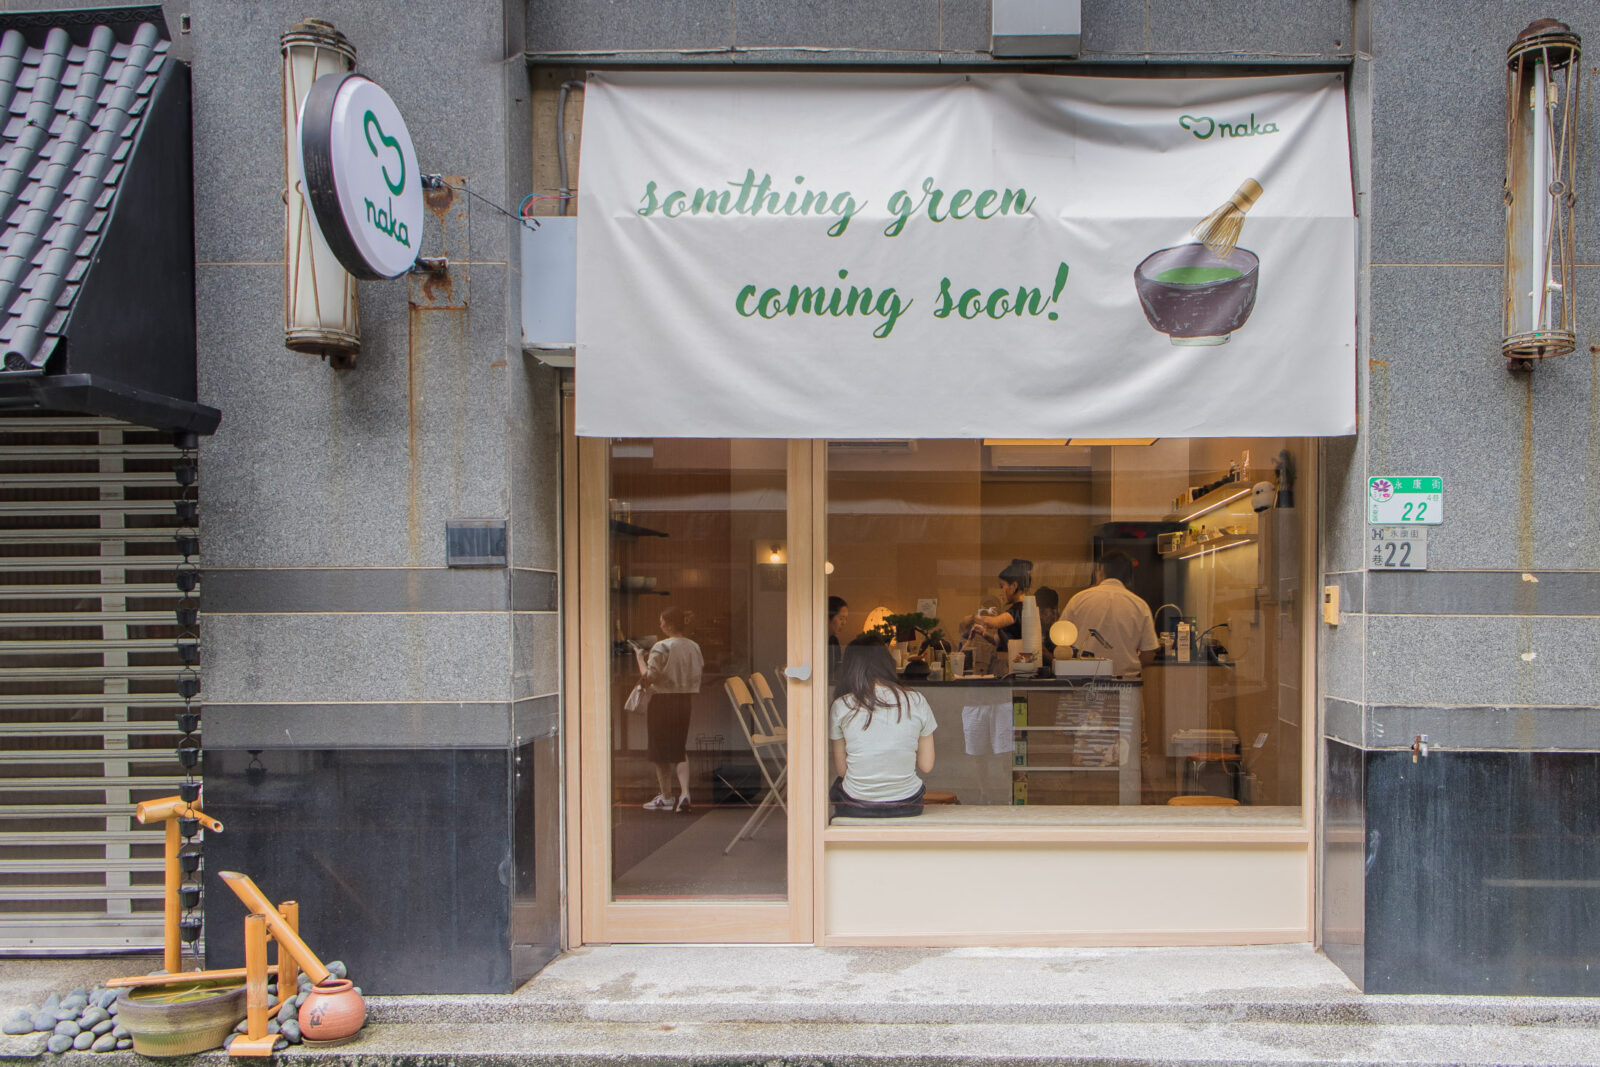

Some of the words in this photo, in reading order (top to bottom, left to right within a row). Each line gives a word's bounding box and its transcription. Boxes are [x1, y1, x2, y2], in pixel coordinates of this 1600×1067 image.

[1218, 112, 1280, 138] naka
[637, 167, 868, 238] somthing
[884, 176, 1037, 237] green
[363, 196, 411, 249] naka
[735, 268, 913, 338] coming
[933, 261, 1070, 321] soon!
[1401, 501, 1428, 521] 22
[1384, 541, 1412, 567] 22
